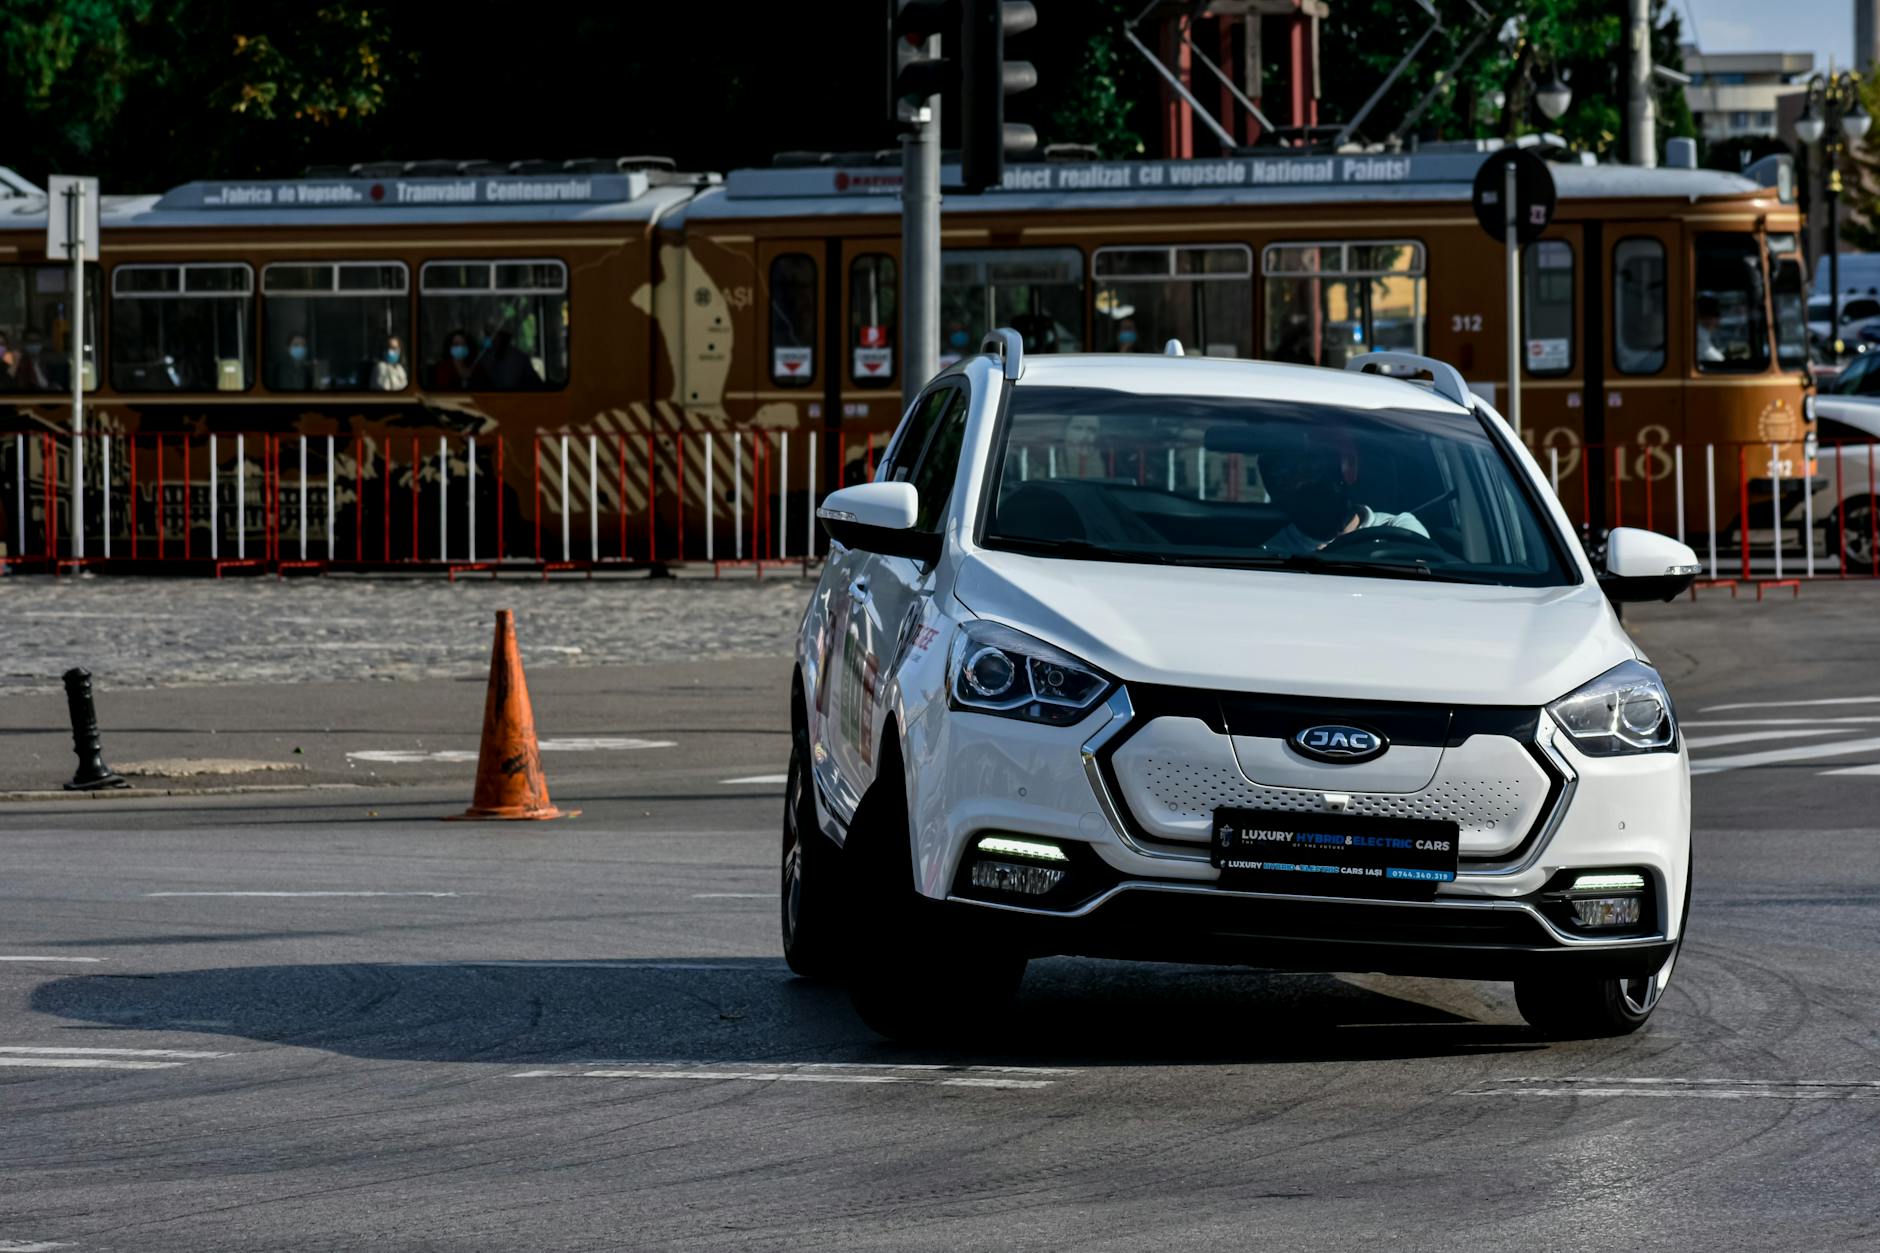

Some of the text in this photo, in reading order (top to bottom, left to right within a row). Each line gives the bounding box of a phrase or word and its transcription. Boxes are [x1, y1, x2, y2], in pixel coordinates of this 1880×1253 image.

[1002, 168, 1051, 189] oiect
[1059, 166, 1130, 187] realizat
[1139, 165, 1164, 184] cu
[1169, 160, 1246, 185] vopsele
[1252, 159, 1335, 183] National
[396, 179, 592, 202] Tramvaiul Centenarului
[1451, 314, 1482, 332] 312
[1310, 731, 1369, 749] JAC
[1241, 829, 1294, 842] LUXURY
[1415, 839, 1451, 851] CARS
[1228, 860, 1262, 869] LUXURY
[1340, 867, 1364, 875] CARS
